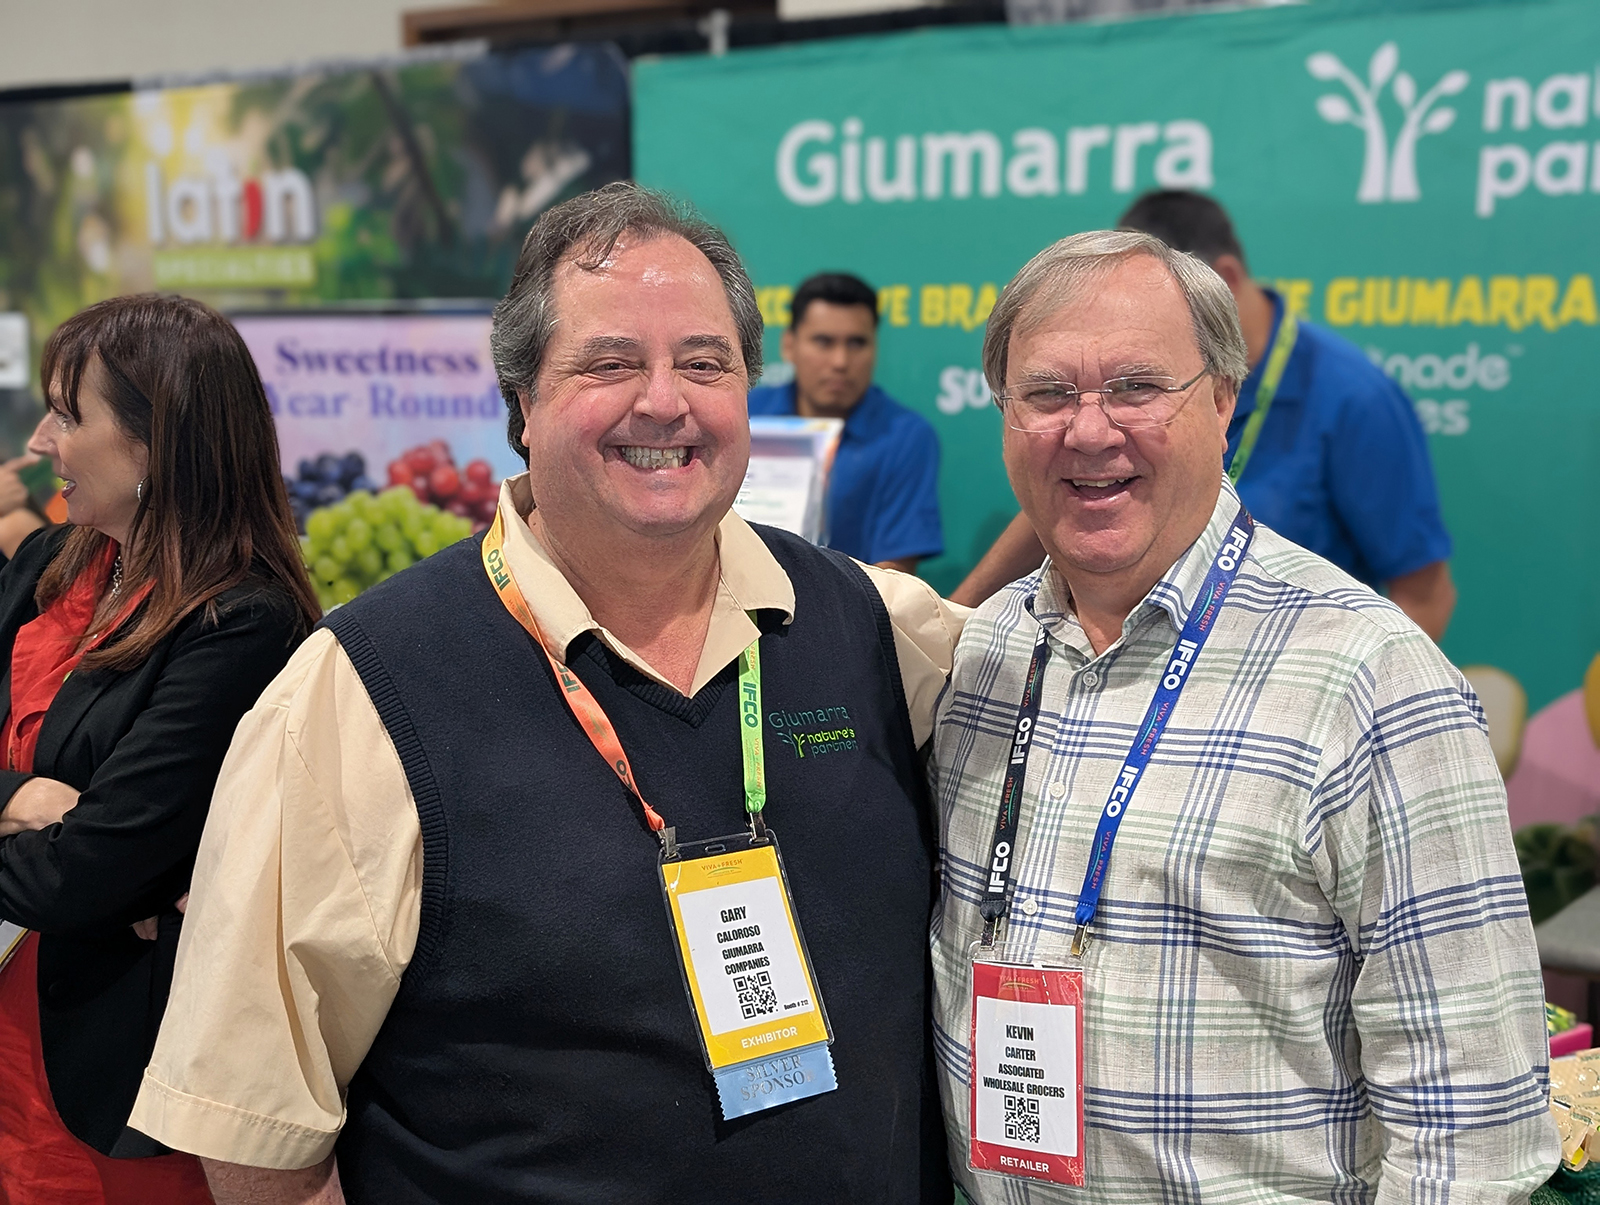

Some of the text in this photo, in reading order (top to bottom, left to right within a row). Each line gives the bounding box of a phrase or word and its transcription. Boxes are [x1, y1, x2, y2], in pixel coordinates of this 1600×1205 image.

[776, 118, 1214, 205] Giumarra
[920, 284, 999, 331] BRA
[1325, 274, 1598, 332] GIUMARRA
[275, 338, 481, 374] Sweetness
[368, 380, 500, 418] Round
[1217, 526, 1249, 571] IFCO
[487, 549, 511, 591] IFCO
[1213, 582, 1226, 600] VIVA
[1199, 604, 1215, 632] FRESH
[555, 661, 581, 693] IFC
[1163, 639, 1198, 690] IFCO
[743, 682, 759, 728] IFCO
[768, 706, 850, 728] Giumarra
[1156, 702, 1169, 722] VIVA
[807, 726, 856, 744] nature's
[1011, 717, 1031, 764] IFCO
[1141, 728, 1158, 755] FRESH
[1000, 777, 1013, 830] VIVA FRESH
[1106, 765, 1139, 818] IFCO
[1101, 831, 1112, 852] VIVA
[988, 841, 1010, 893] IFCO
[1091, 859, 1104, 890] FRESH
[720, 906, 746, 923] GARY
[716, 925, 761, 943] CALOROSO
[722, 942, 765, 960] GIUMARRA
[724, 956, 770, 975] COMPANIES
[741, 1026, 798, 1049] EXHIBITOR
[1006, 1024, 1034, 1041] KEVIN
[1005, 1046, 1036, 1061] CARTER
[746, 1055, 803, 1082] SILVER
[998, 1063, 1045, 1079] ASSOCIATED
[983, 1076, 1065, 1098] WHOLESALE GROCERS
[1000, 1155, 1050, 1173] RETAILER
